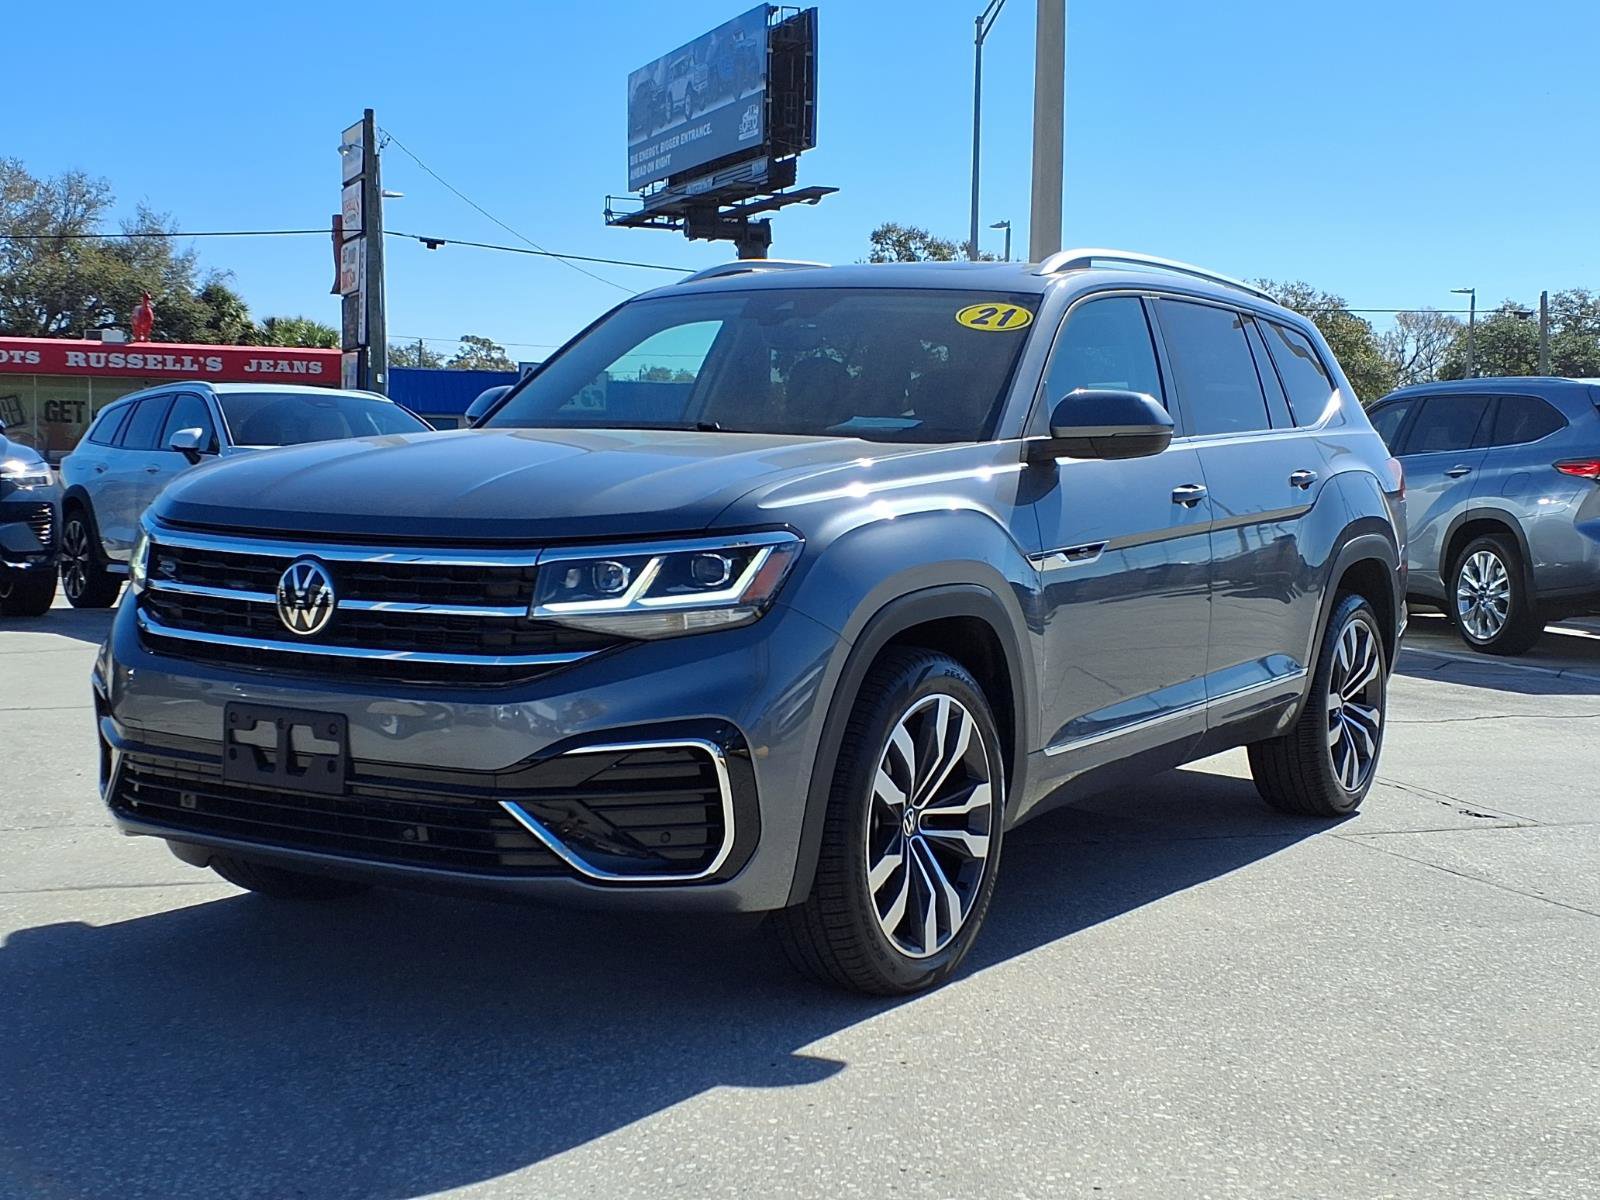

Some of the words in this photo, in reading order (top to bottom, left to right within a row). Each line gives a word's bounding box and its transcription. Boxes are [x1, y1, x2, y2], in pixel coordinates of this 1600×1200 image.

[970, 306, 1018, 328] 21
[65, 350, 224, 373] RUSSELL'S
[243, 358, 323, 375] JEANS
[45, 399, 86, 424] GET
